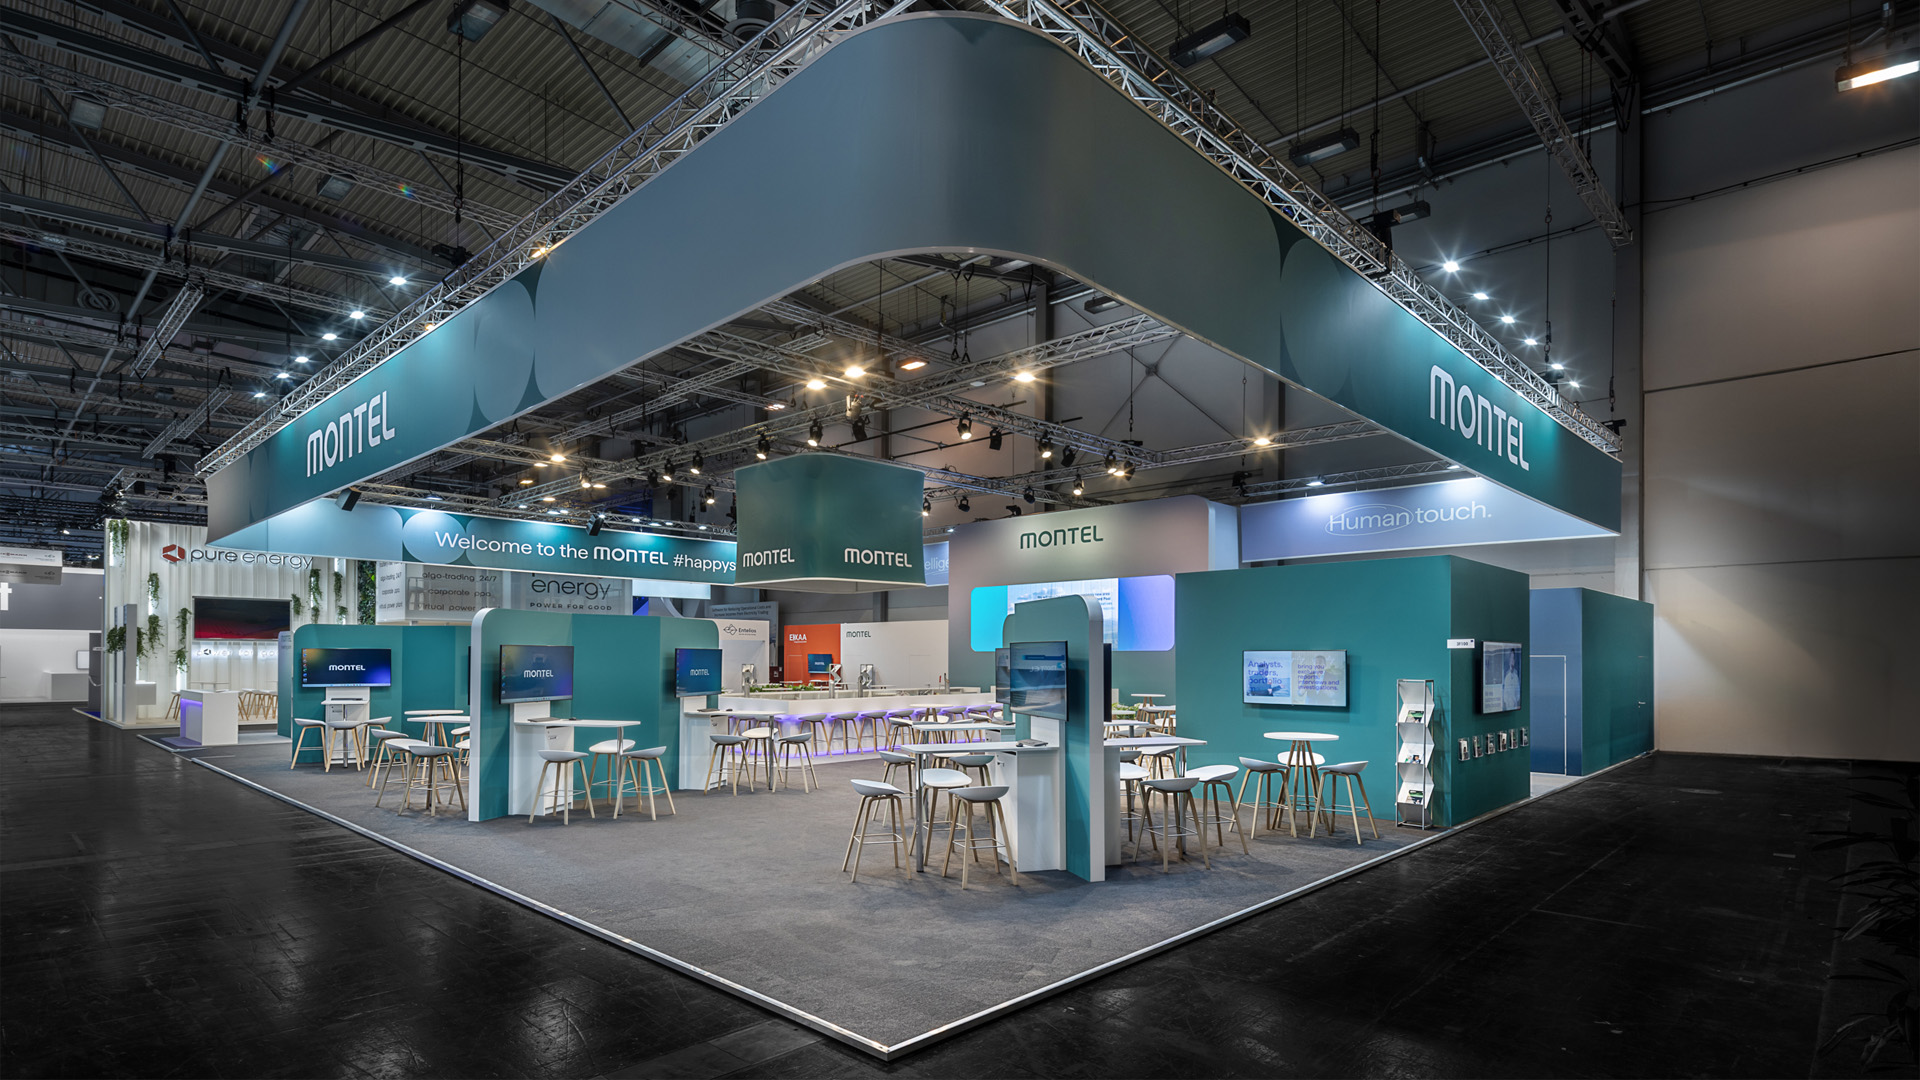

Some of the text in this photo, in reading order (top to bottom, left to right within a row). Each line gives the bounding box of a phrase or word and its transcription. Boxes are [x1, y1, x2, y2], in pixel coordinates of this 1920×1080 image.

[1430, 365, 1530, 471] MONTEL
[306, 391, 396, 478] MONTEL
[1329, 501, 1492, 533] Human touch.
[1020, 525, 1104, 549] MONTEL
[190, 548, 314, 569] pure energy
[435, 531, 737, 574] Welcome to the MONTEL #happys
[743, 548, 795, 568] MONTEL
[844, 548, 913, 568] MONTEL
[427, 588, 470, 596] corporate
[531, 579, 611, 600] energy
[448, 604, 476, 612] power
[846, 630, 872, 638] MONTEL
[523, 669, 554, 679] MONTEL
[689, 667, 710, 676] MONTEL
[1247, 660, 1283, 669] Analysts,
